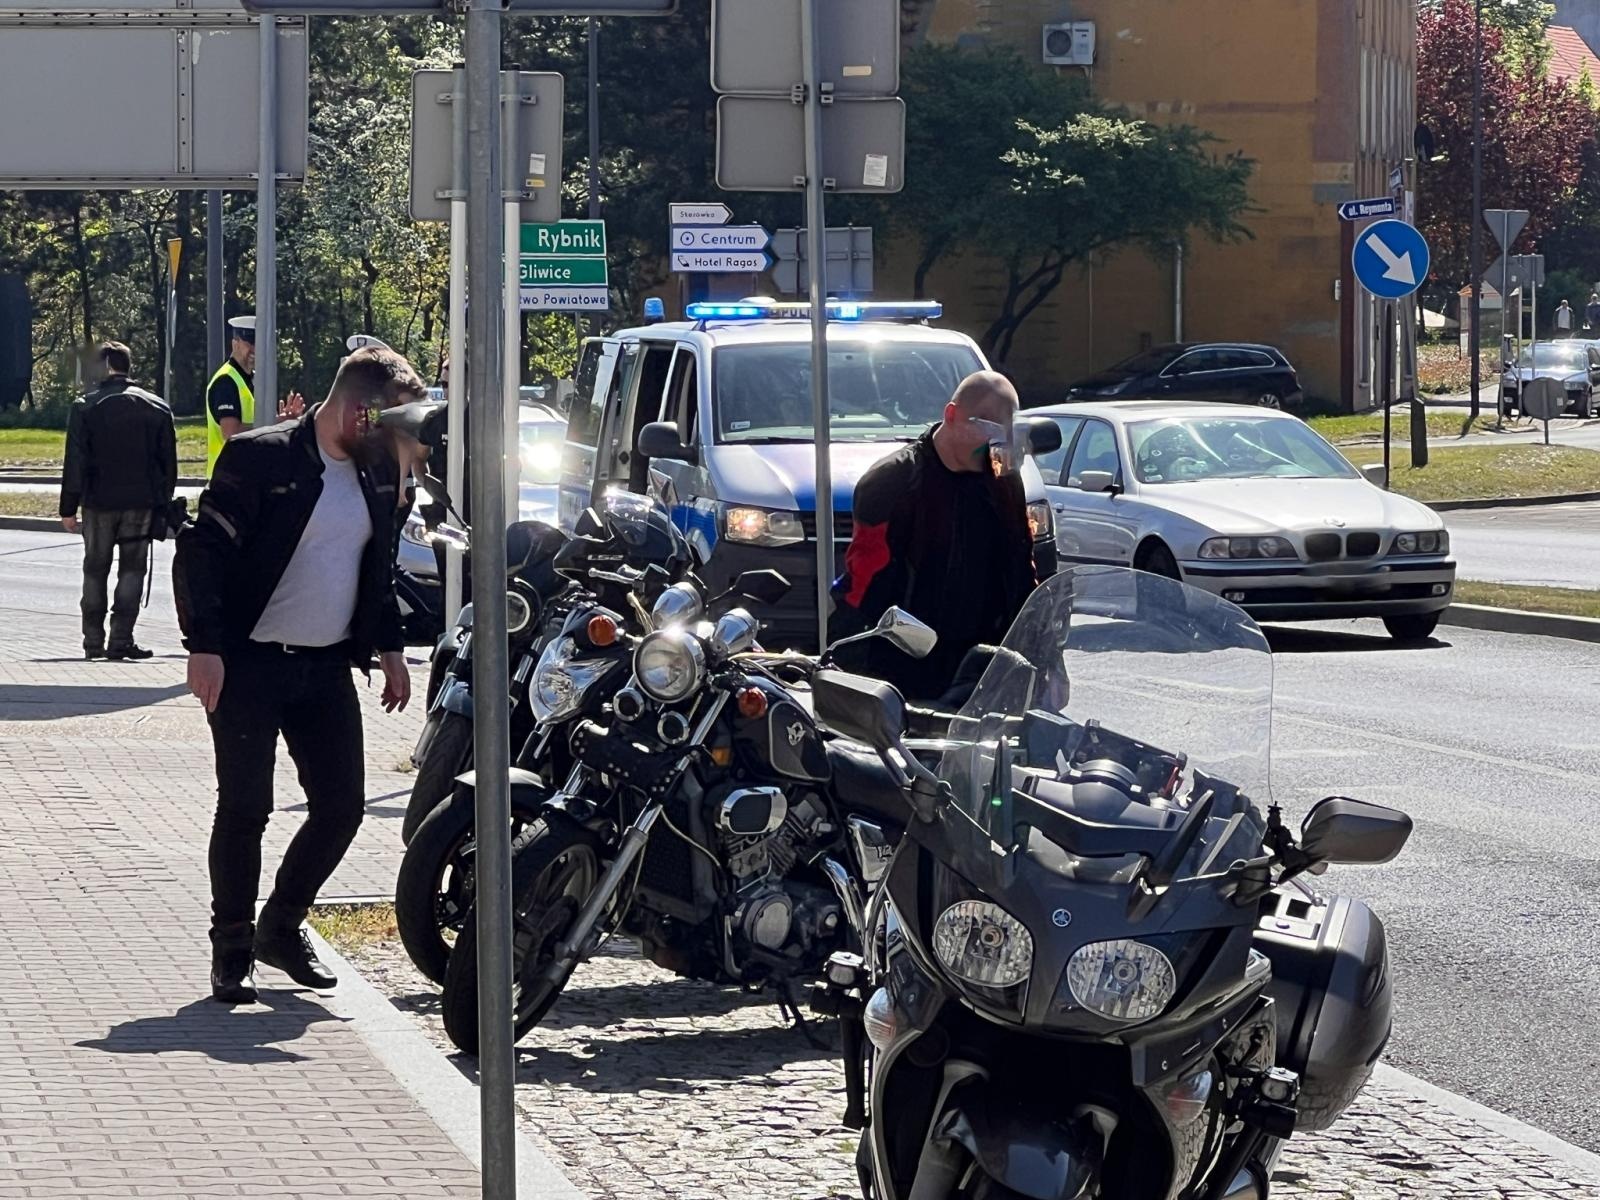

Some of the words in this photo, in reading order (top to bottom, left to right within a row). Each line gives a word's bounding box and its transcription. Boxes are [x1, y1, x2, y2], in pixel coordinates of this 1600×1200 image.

[538, 228, 601, 252] Rybnik
[701, 233, 756, 245] Centrum
[694, 257, 722, 267] Hotel
[519, 264, 571, 279] Gliwice
[543, 293, 606, 305] Powiatowe
